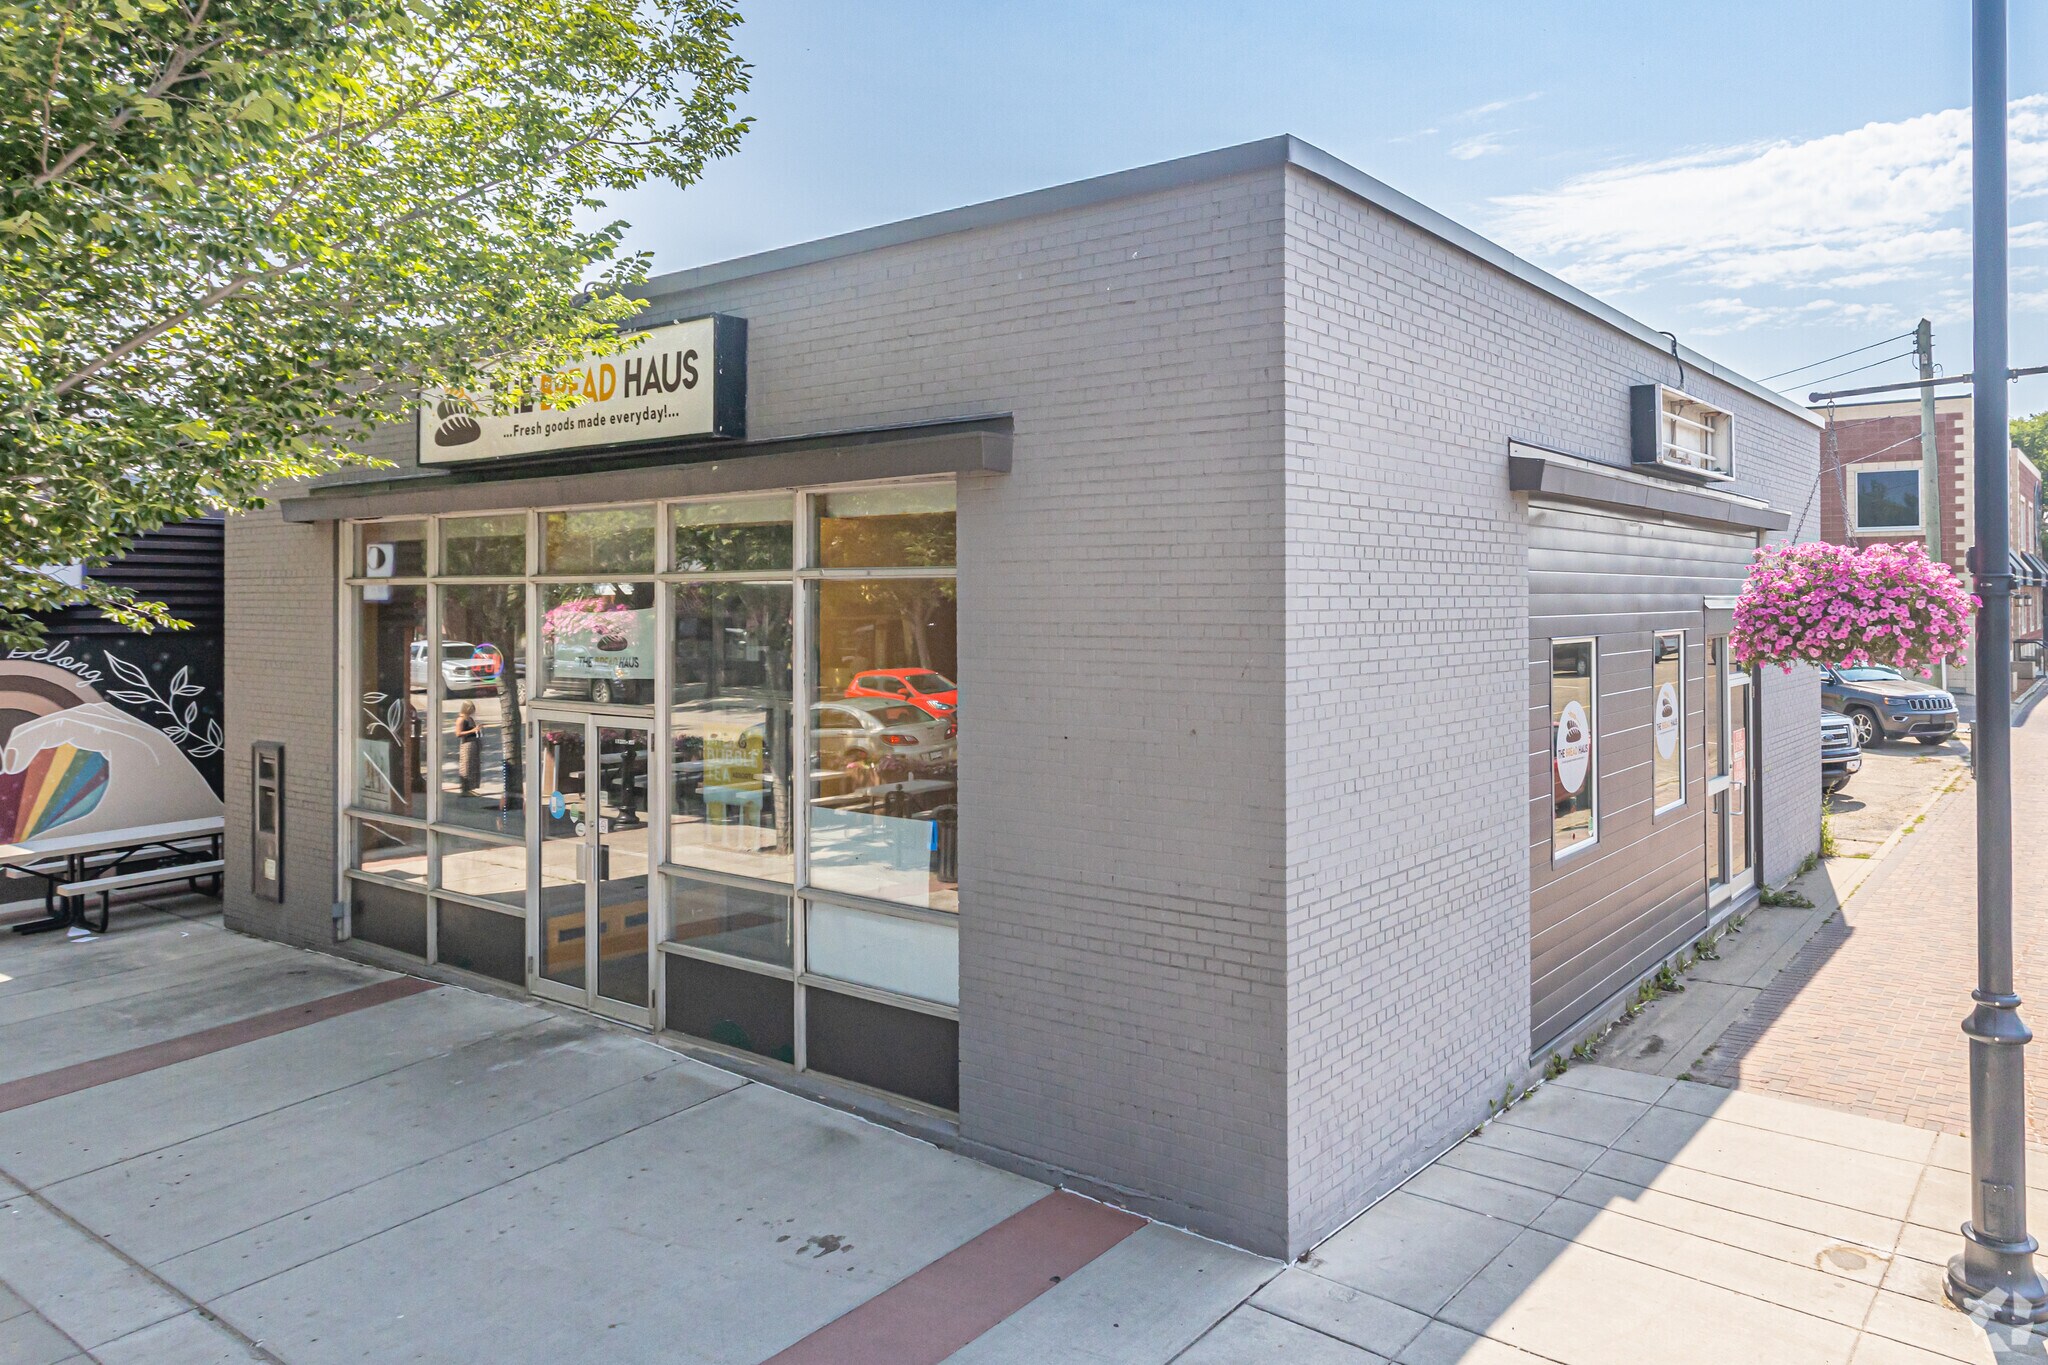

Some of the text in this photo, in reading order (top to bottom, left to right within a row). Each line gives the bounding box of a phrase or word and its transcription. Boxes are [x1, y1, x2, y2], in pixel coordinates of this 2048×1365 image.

[624, 349, 699, 398] HAUS
[503, 404, 679, 438] ...Fresh goods made everyday!...
[578, 656, 593, 668] THE
[618, 656, 640, 668] HAUS
